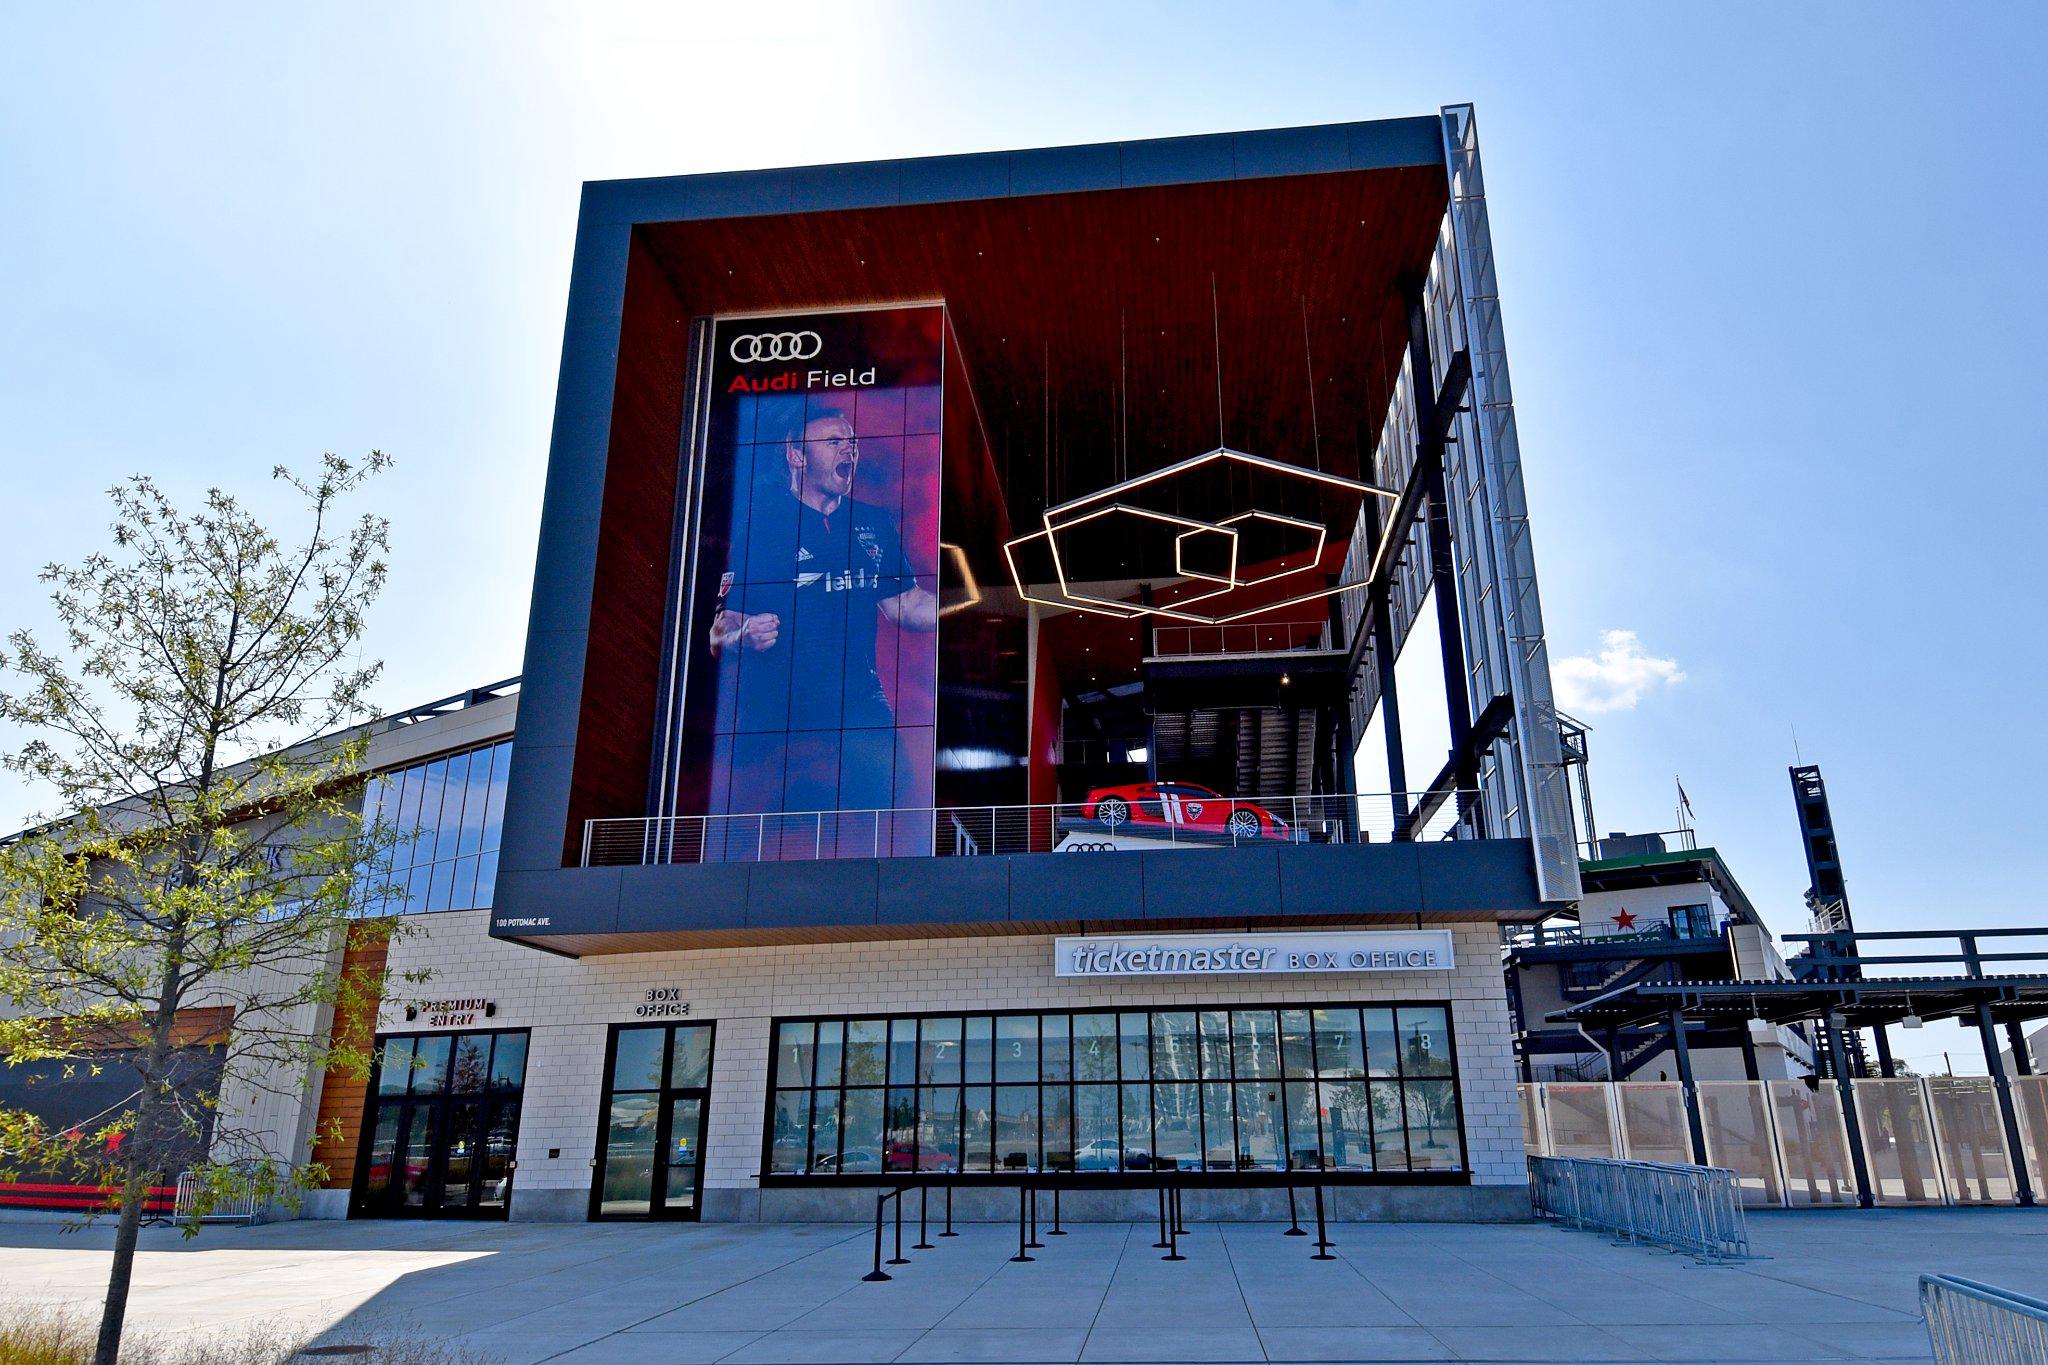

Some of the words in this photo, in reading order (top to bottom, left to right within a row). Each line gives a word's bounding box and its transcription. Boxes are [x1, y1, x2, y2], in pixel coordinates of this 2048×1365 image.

[728, 372, 798, 393] Audi
[807, 366, 876, 389] Field
[496, 918, 508, 928] 100
[508, 917, 537, 927] POTOMAC
[536, 917, 551, 926] AVE.
[1072, 942, 1276, 973] ticketmaster
[1288, 951, 1338, 969] BOX
[1350, 949, 1437, 968] OFFICE
[646, 988, 679, 1001] BOX
[635, 1003, 689, 1017] OFFICE
[429, 1013, 474, 1027] ENTRY
[935, 1041, 946, 1059] 2
[1012, 1041, 1022, 1058] 3
[1088, 1040, 1100, 1057] 4
[1334, 1034, 1344, 1051] 7
[1421, 1033, 1432, 1050] 8
[792, 1047, 799, 1063] 1
